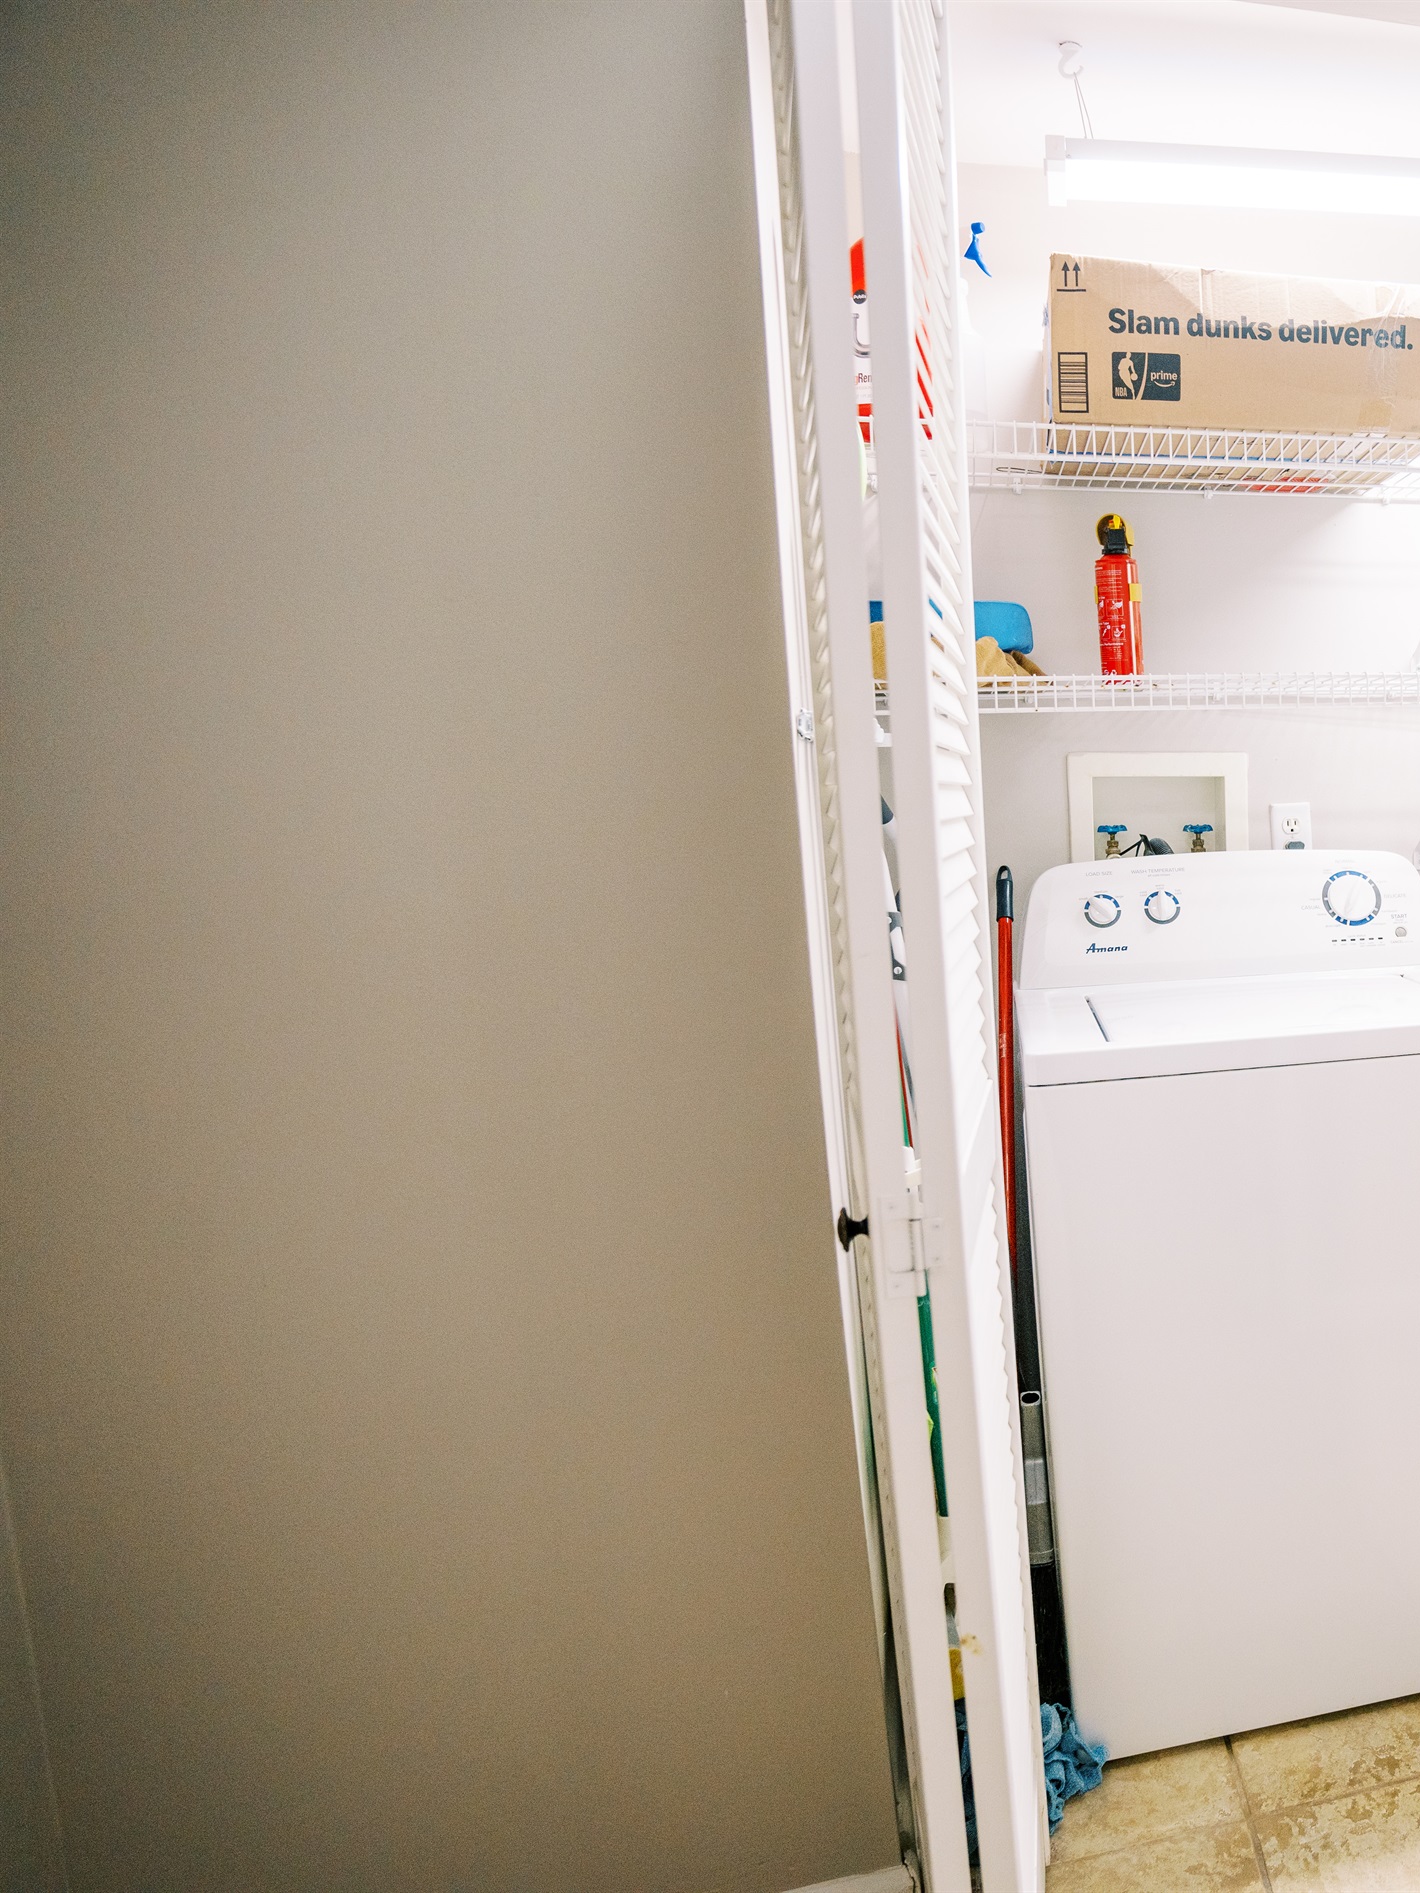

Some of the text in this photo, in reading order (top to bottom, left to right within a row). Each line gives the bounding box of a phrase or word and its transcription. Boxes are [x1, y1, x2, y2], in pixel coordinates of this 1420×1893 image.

[1108, 307, 1414, 351] Slam dunks delivered.
[1150, 370, 1178, 381] prime
[1115, 386, 1128, 397] NBA
[1085, 942, 1128, 954] Amana
